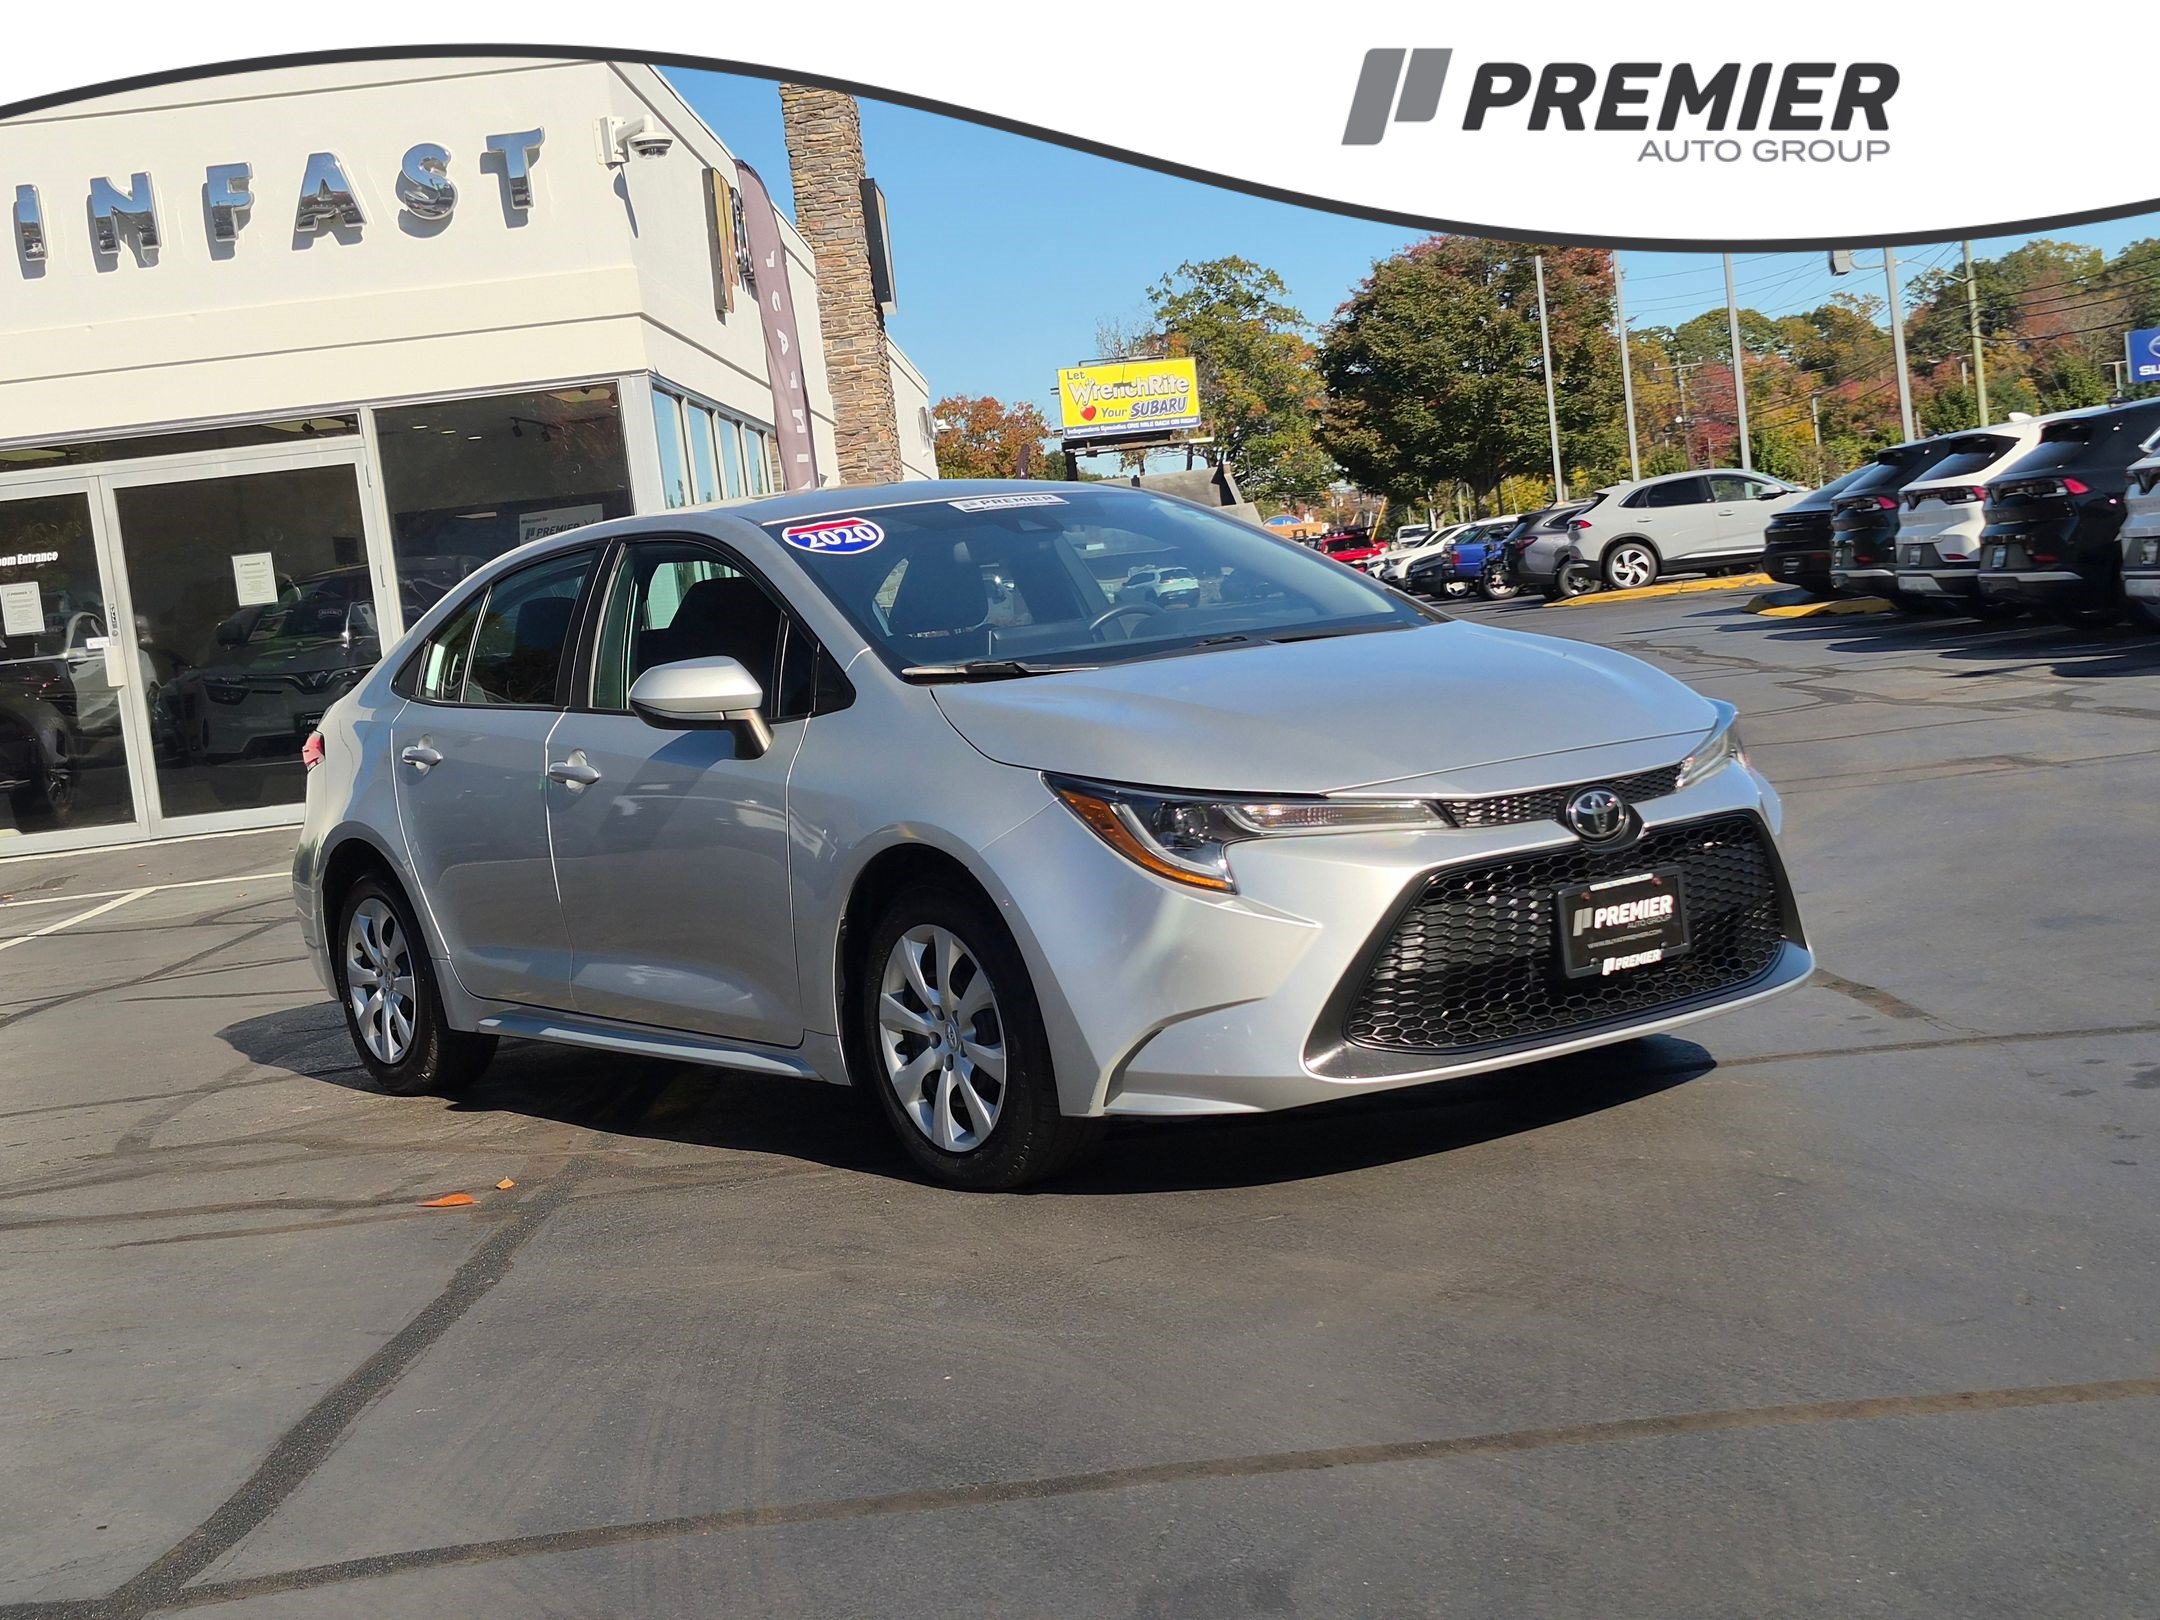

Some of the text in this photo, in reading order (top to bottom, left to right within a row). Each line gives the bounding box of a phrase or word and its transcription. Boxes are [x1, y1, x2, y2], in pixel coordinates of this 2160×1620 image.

[1066, 371, 1085, 381] Let
[1068, 374, 1190, 406] WrenchRite
[1101, 397, 1187, 419] Your SUBARU
[980, 496, 1053, 506] PREMIER
[799, 526, 877, 548] 2020
[17, 551, 58, 565] Entrance
[1594, 894, 1674, 929] PREMIER
[1627, 914, 1673, 929] AUTO GROUP
[1615, 949, 1664, 971] PREMIER
